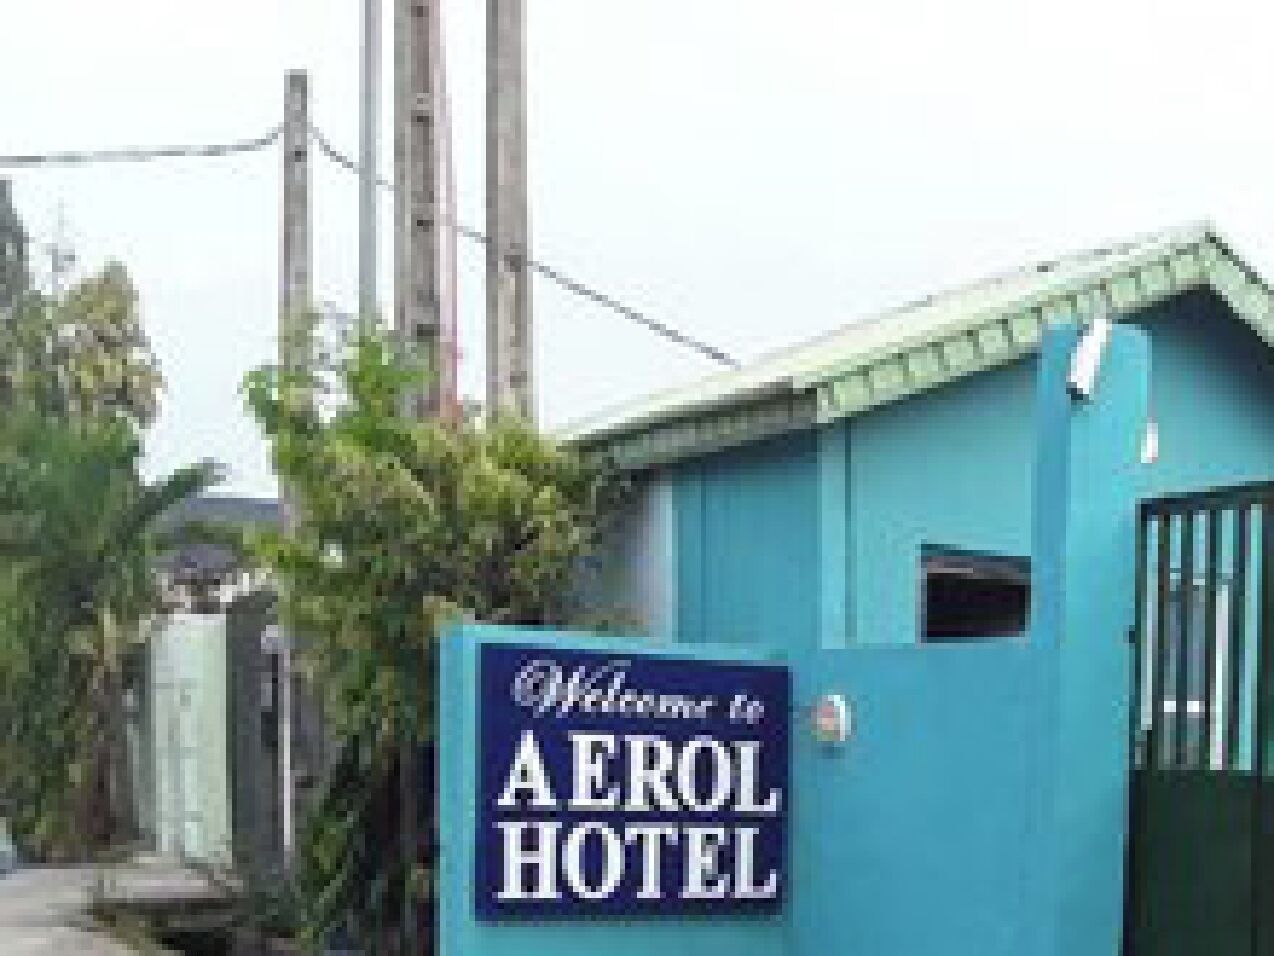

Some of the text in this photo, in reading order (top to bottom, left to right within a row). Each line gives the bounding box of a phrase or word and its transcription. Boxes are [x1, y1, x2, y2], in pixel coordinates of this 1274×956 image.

[510, 659, 765, 725] Welcome to
[497, 729, 783, 812] AEROL
[495, 821, 778, 899] HOTEL
